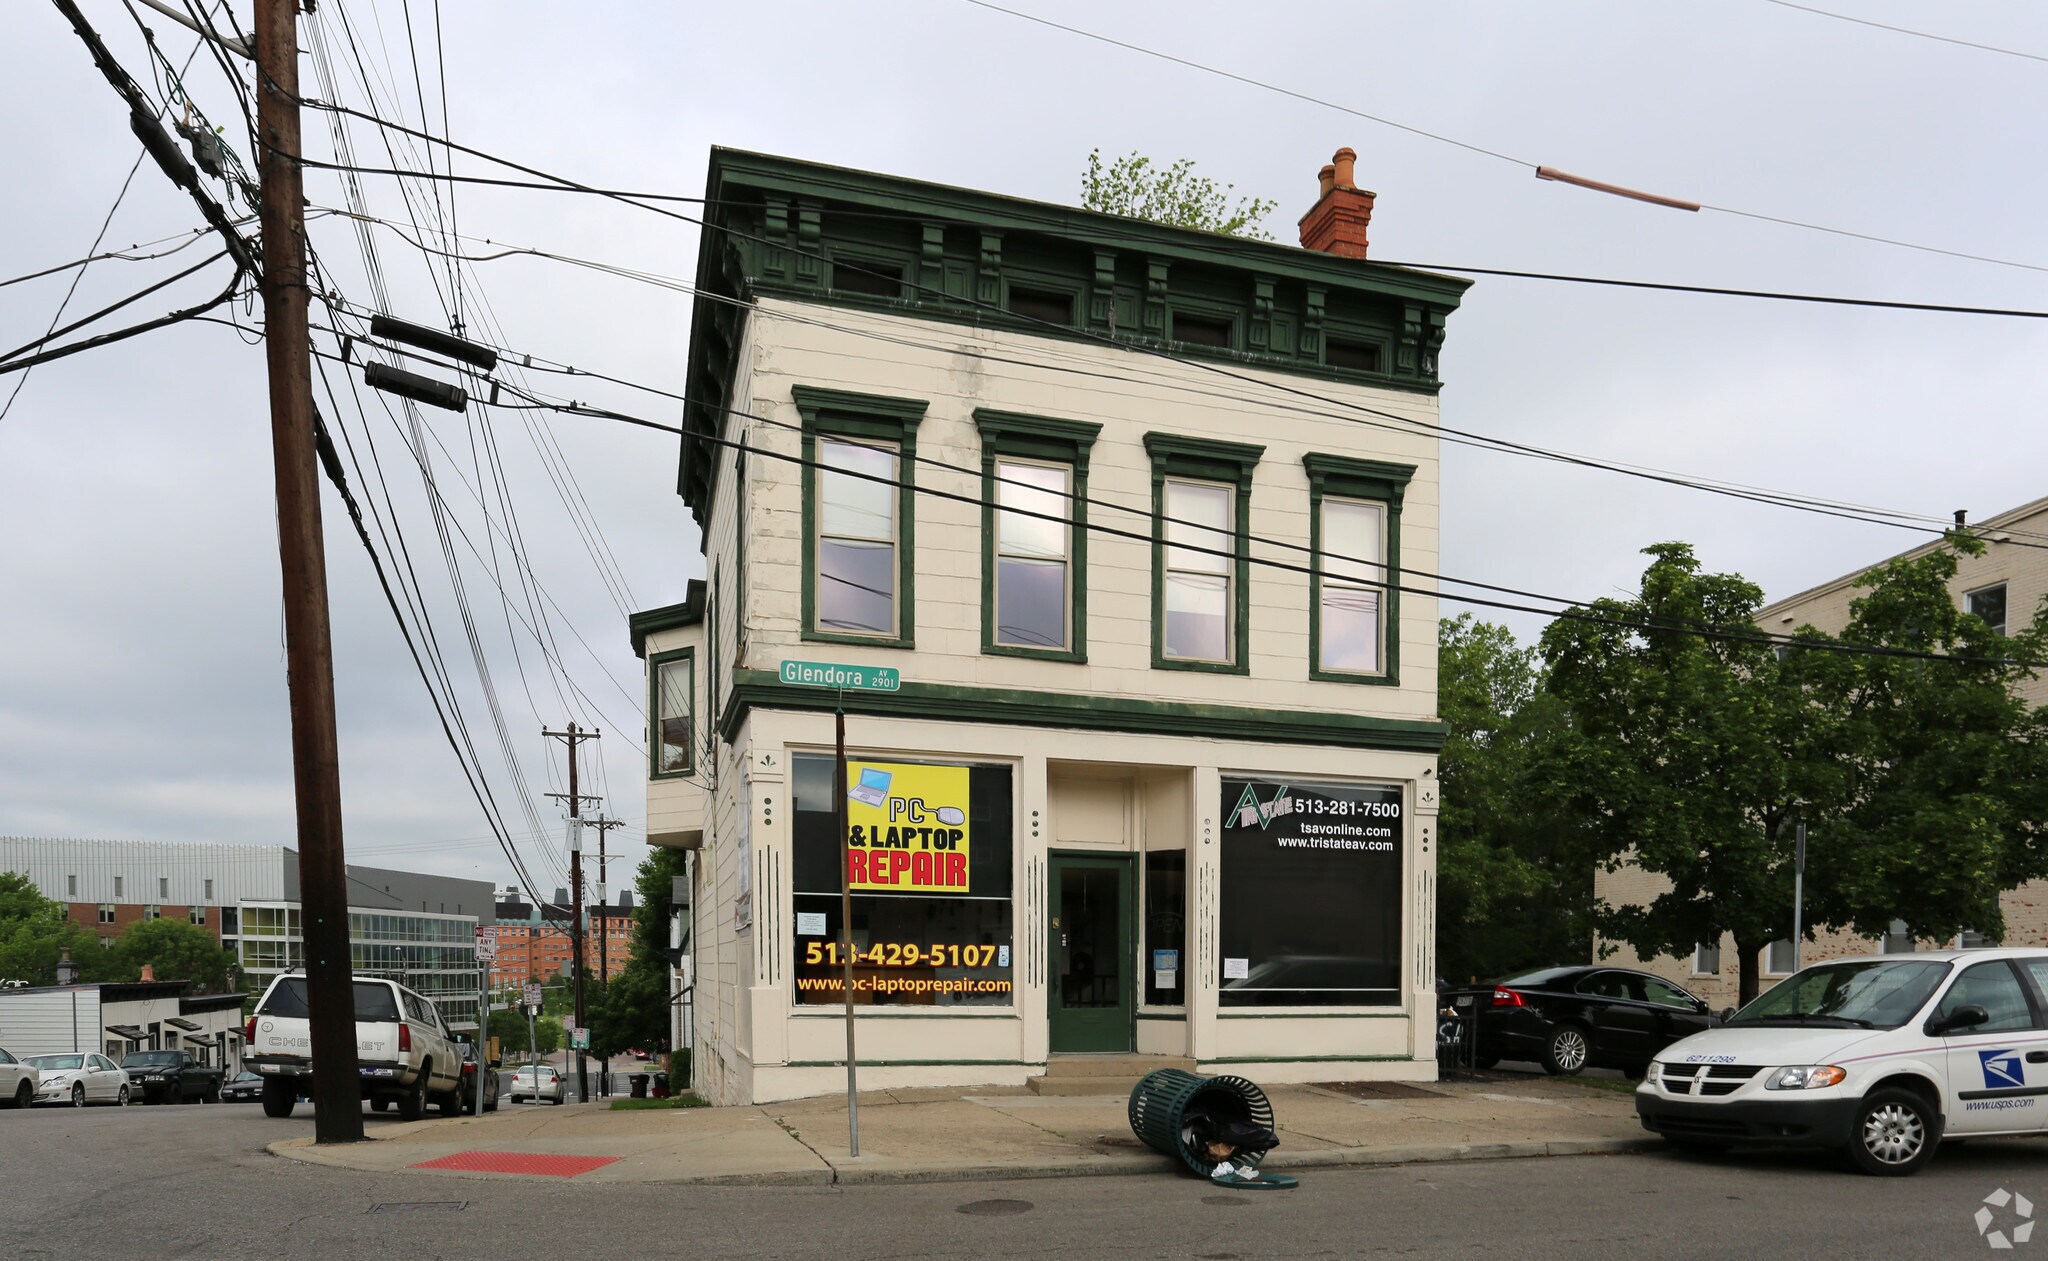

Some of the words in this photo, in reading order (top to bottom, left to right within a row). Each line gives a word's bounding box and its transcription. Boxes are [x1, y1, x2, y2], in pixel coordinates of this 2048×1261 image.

[785, 662, 863, 686] Glendora
[872, 678, 894, 688] 2901
[889, 796, 925, 824] PC
[1295, 799, 1400, 818] 513-281-7500
[849, 825, 867, 847] &
[871, 825, 964, 851] LAPTOP
[1300, 822, 1392, 837] tsavonline.com
[1278, 837, 1394, 851] www.tristateav.com
[848, 849, 967, 887] REPAIR
[1966, 1098, 2035, 1111] www.usps.com
